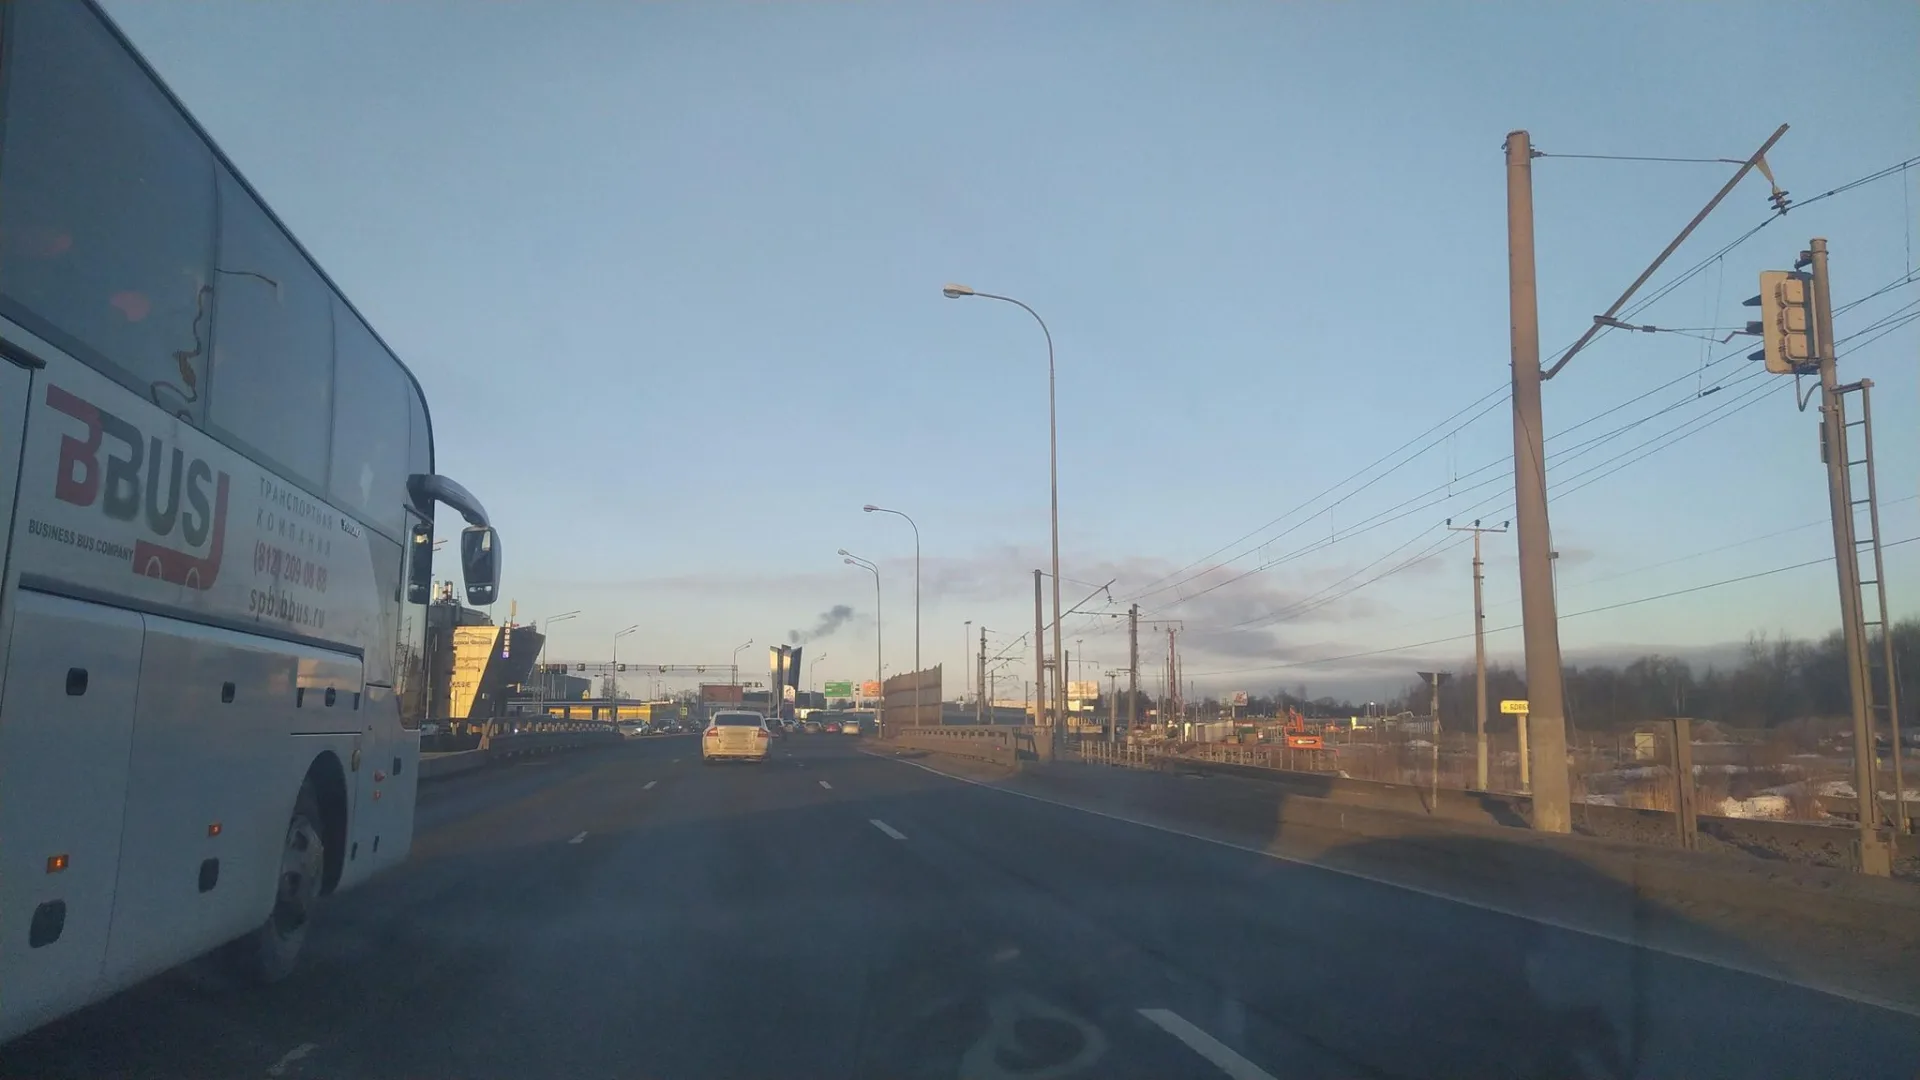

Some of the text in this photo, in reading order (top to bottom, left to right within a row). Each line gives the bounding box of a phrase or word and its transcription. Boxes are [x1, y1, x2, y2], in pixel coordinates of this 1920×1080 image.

[259, 476, 333, 531] ТРАНСПОРТНАЯ
[28, 519, 134, 563] BUSINESS BUS COMPANY
[256, 506, 331, 559] КОМПАНИЯ
[253, 539, 282, 577] (812)
[284, 553, 302, 585] 209
[248, 585, 326, 629] spb.bbus.ru
